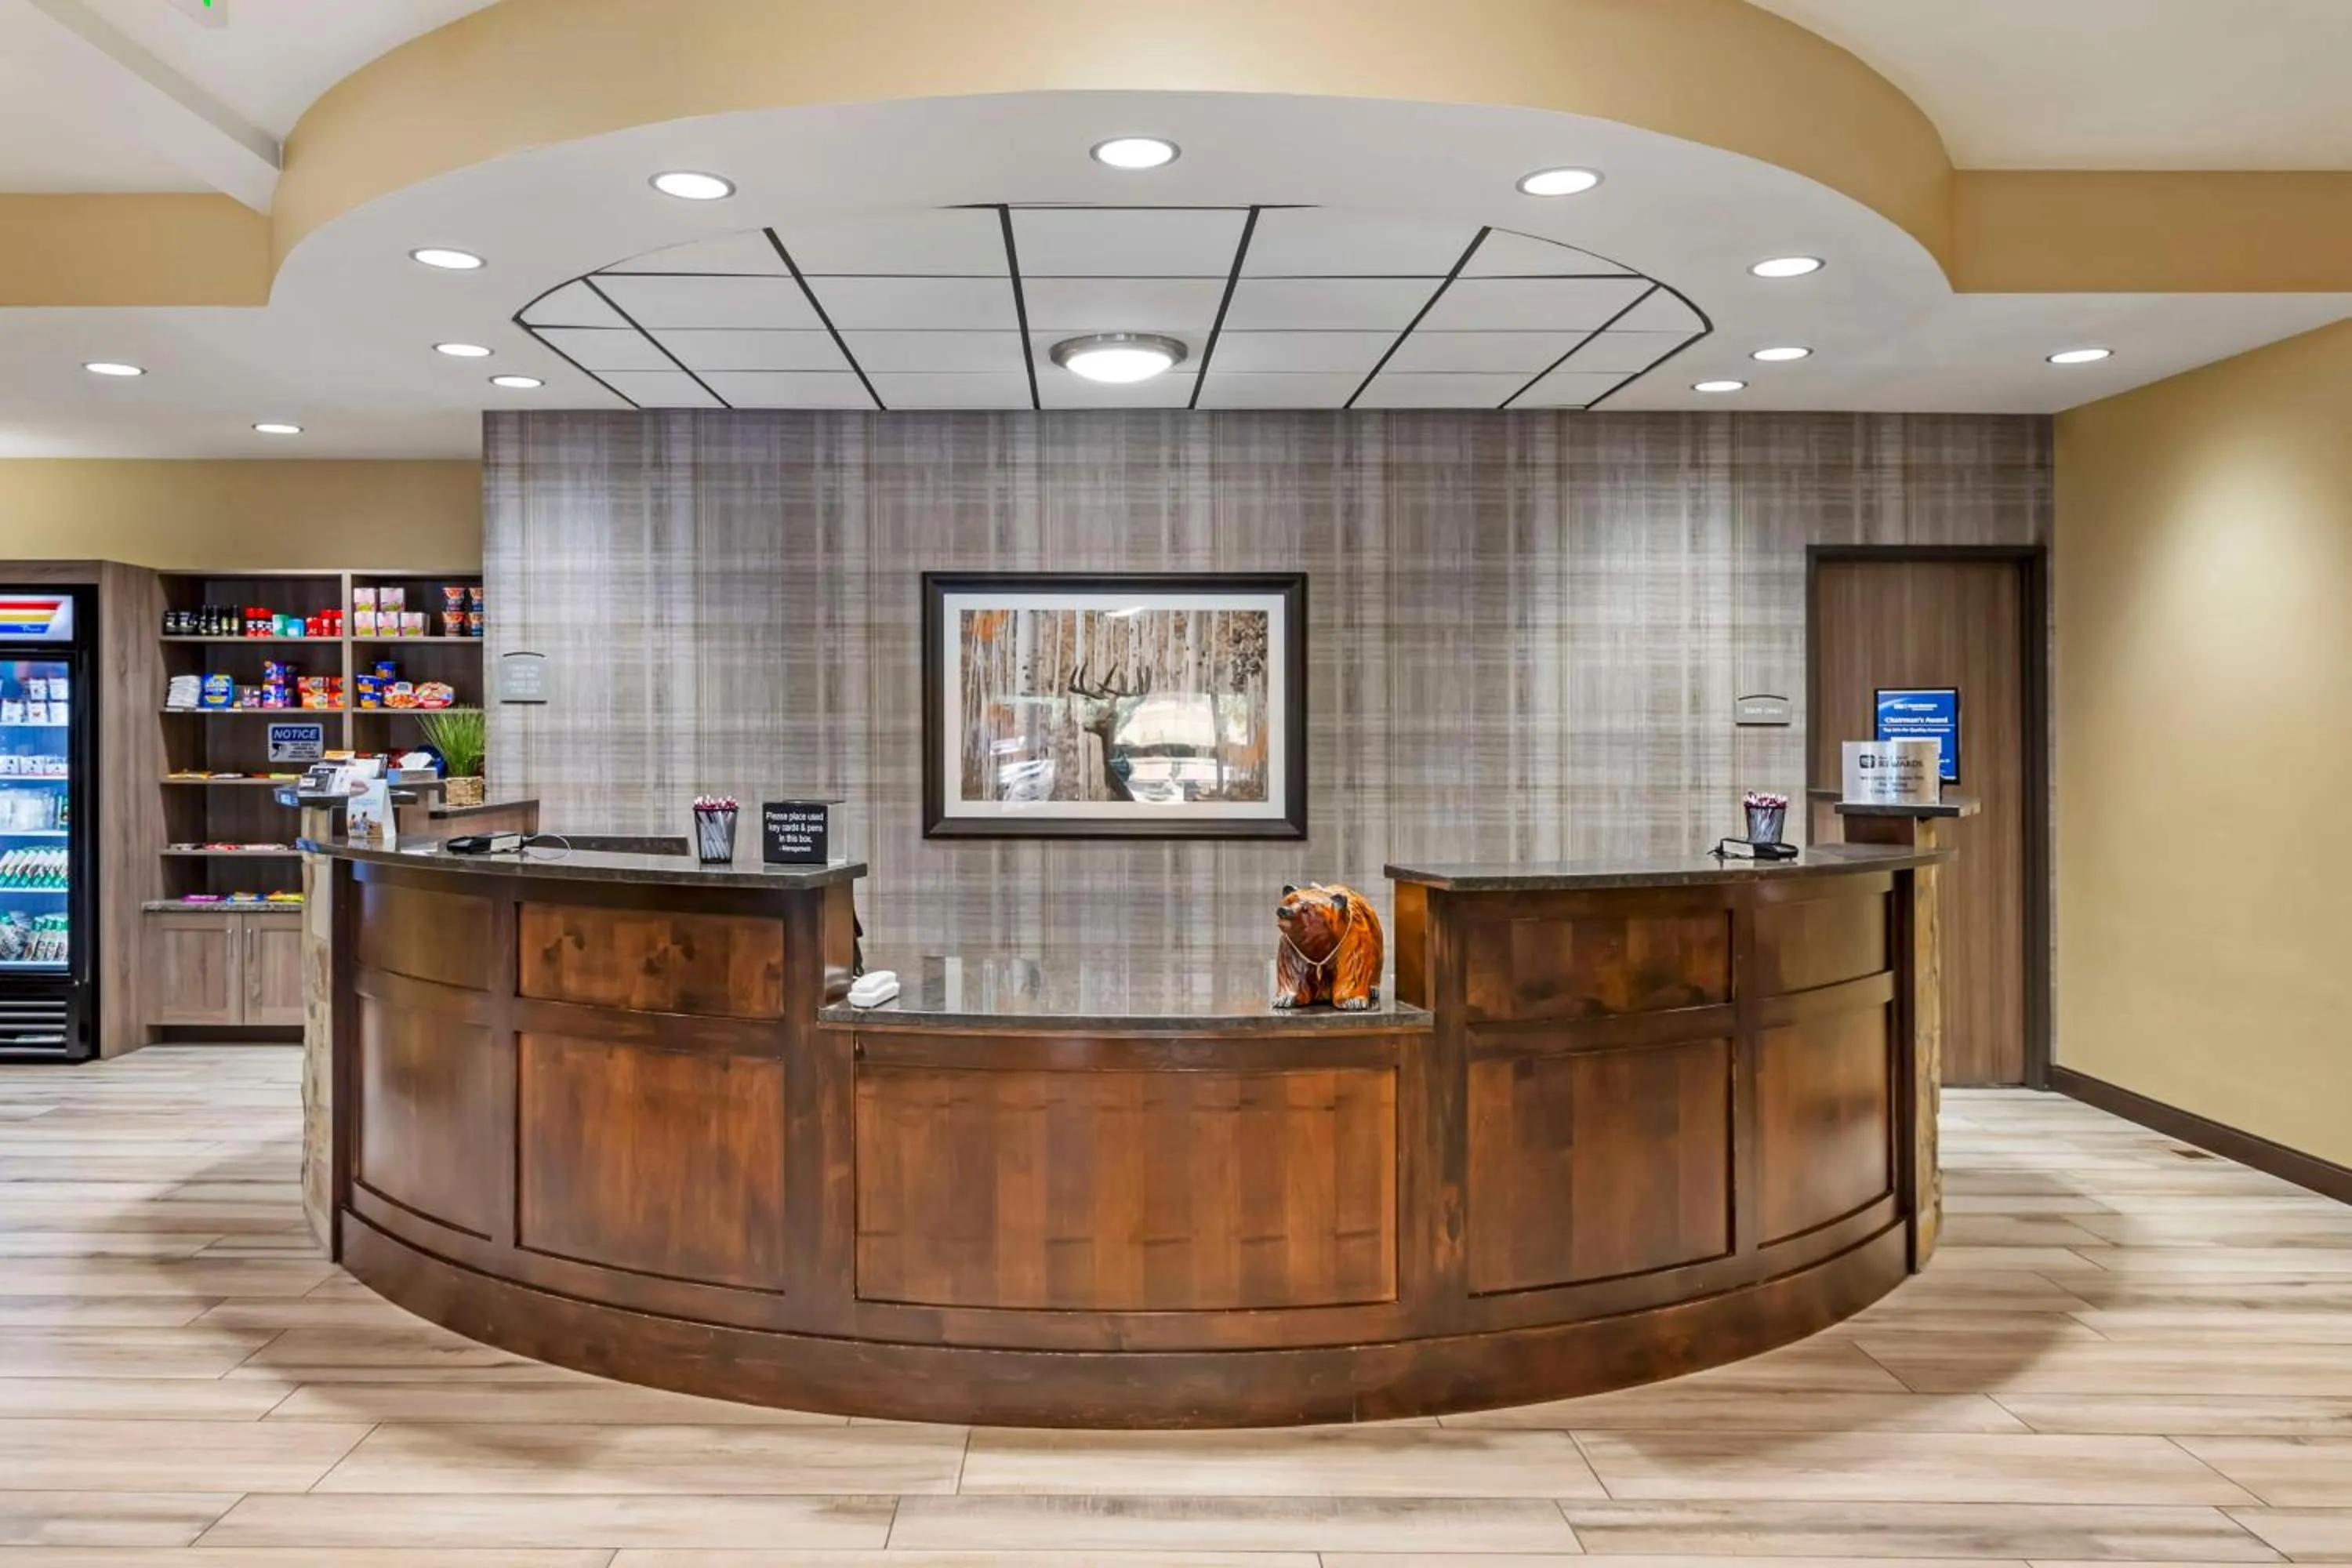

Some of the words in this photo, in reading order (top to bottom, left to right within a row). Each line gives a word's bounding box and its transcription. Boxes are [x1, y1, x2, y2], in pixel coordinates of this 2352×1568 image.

[274, 728, 318, 739] NOTICE
[766, 812, 787, 821] Please
[789, 812, 806, 822] place
[768, 823, 780, 833] key
[782, 823, 799, 832] cards
[800, 823, 806, 832] &
[807, 825, 823, 833] pens
[779, 834, 786, 843] in
[786, 834, 797, 843] this
